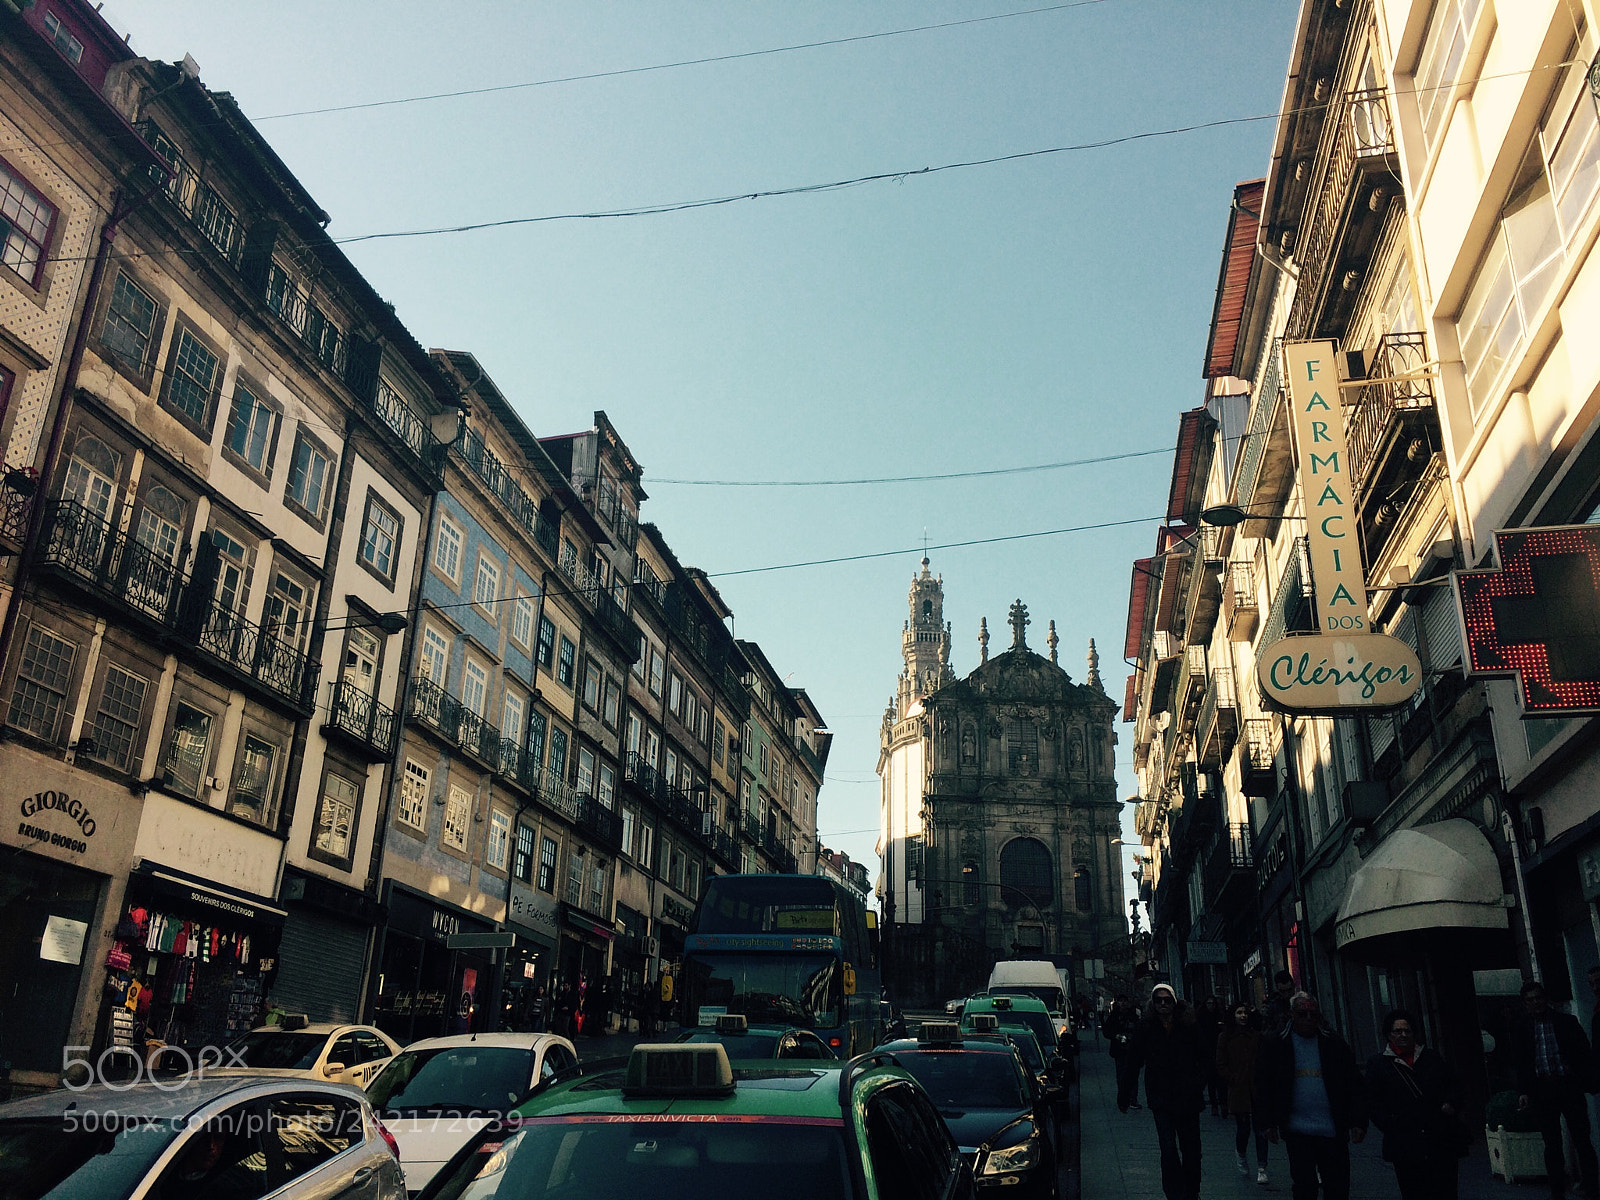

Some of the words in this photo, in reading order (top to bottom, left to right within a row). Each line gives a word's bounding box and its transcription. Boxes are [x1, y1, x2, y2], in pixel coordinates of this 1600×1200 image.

[1304, 359, 1358, 607] FARMÁCIA
[1327, 614, 1364, 631] DOS
[1269, 651, 1416, 699] Clérigos
[21, 790, 96, 837] GIORGIO
[18, 822, 51, 843] BRUNO
[51, 833, 87, 854] GIORGIO
[191, 892, 220, 908] SOUVENIRS
[220, 901, 231, 911] DOS
[607, 1114, 718, 1123] TAXISINVICTA
